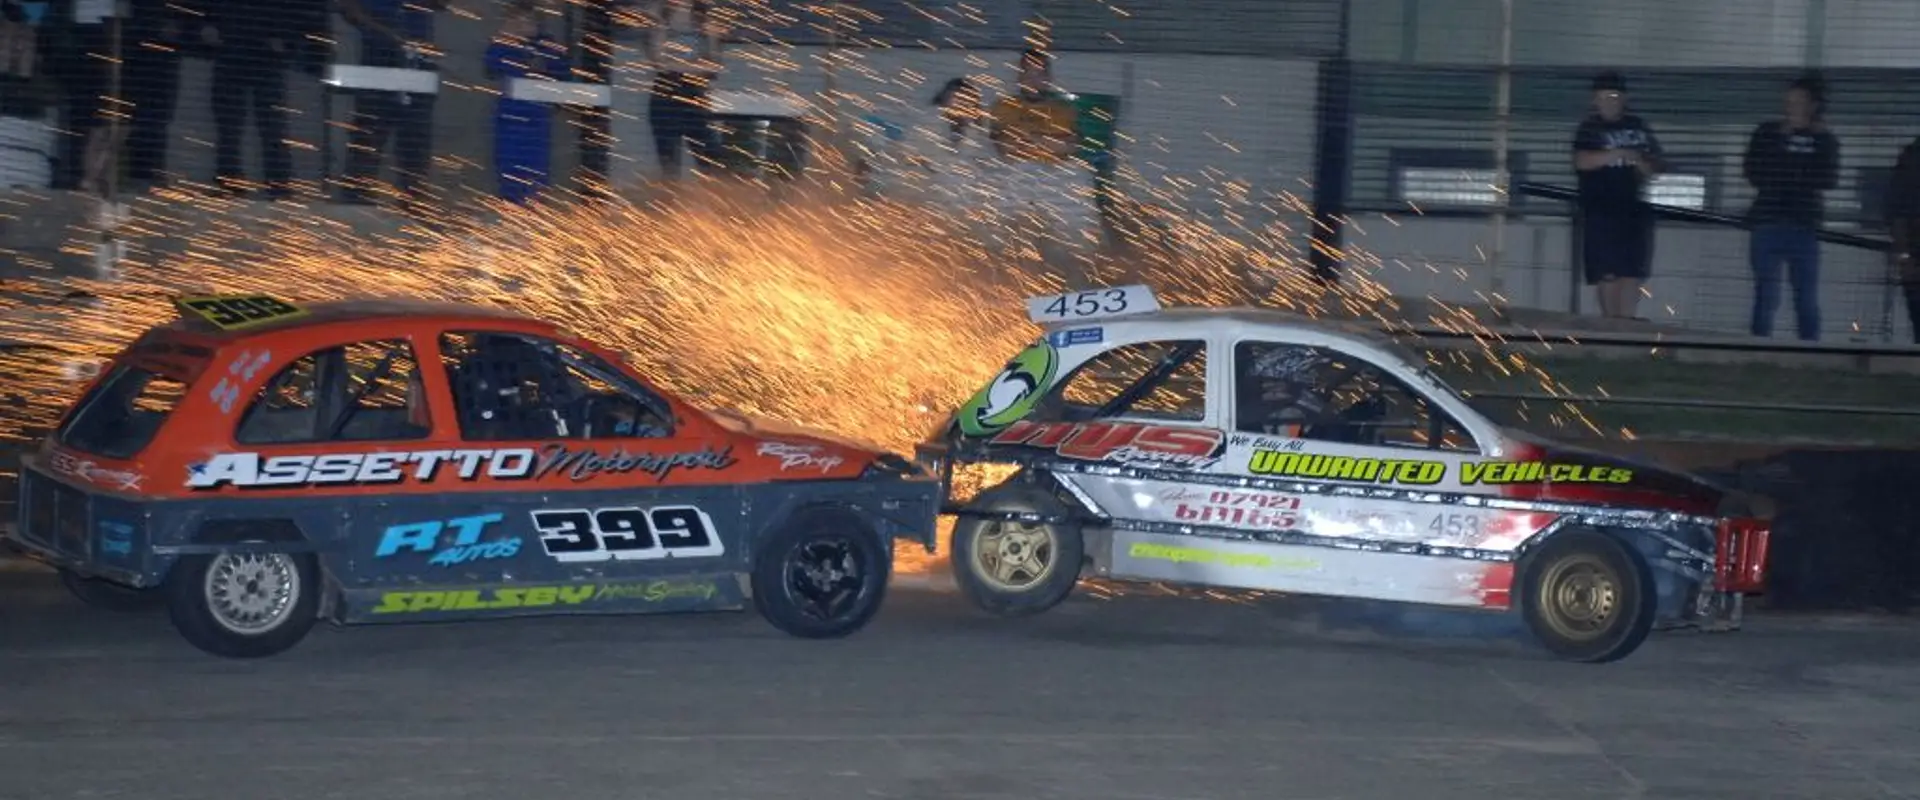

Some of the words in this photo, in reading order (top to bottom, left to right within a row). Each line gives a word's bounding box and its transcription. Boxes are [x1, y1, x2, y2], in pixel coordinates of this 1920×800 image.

[1043, 288, 1128, 318] 453
[185, 447, 535, 489] ASSETTO
[535, 443, 739, 483] Motorsport
[1249, 449, 1446, 485] UNWANTED
[1459, 459, 1633, 485] VEHICLES
[374, 512, 503, 557] RT
[531, 505, 725, 562] 399
[1428, 512, 1480, 537] 453
[372, 584, 596, 613] SPILSBY
